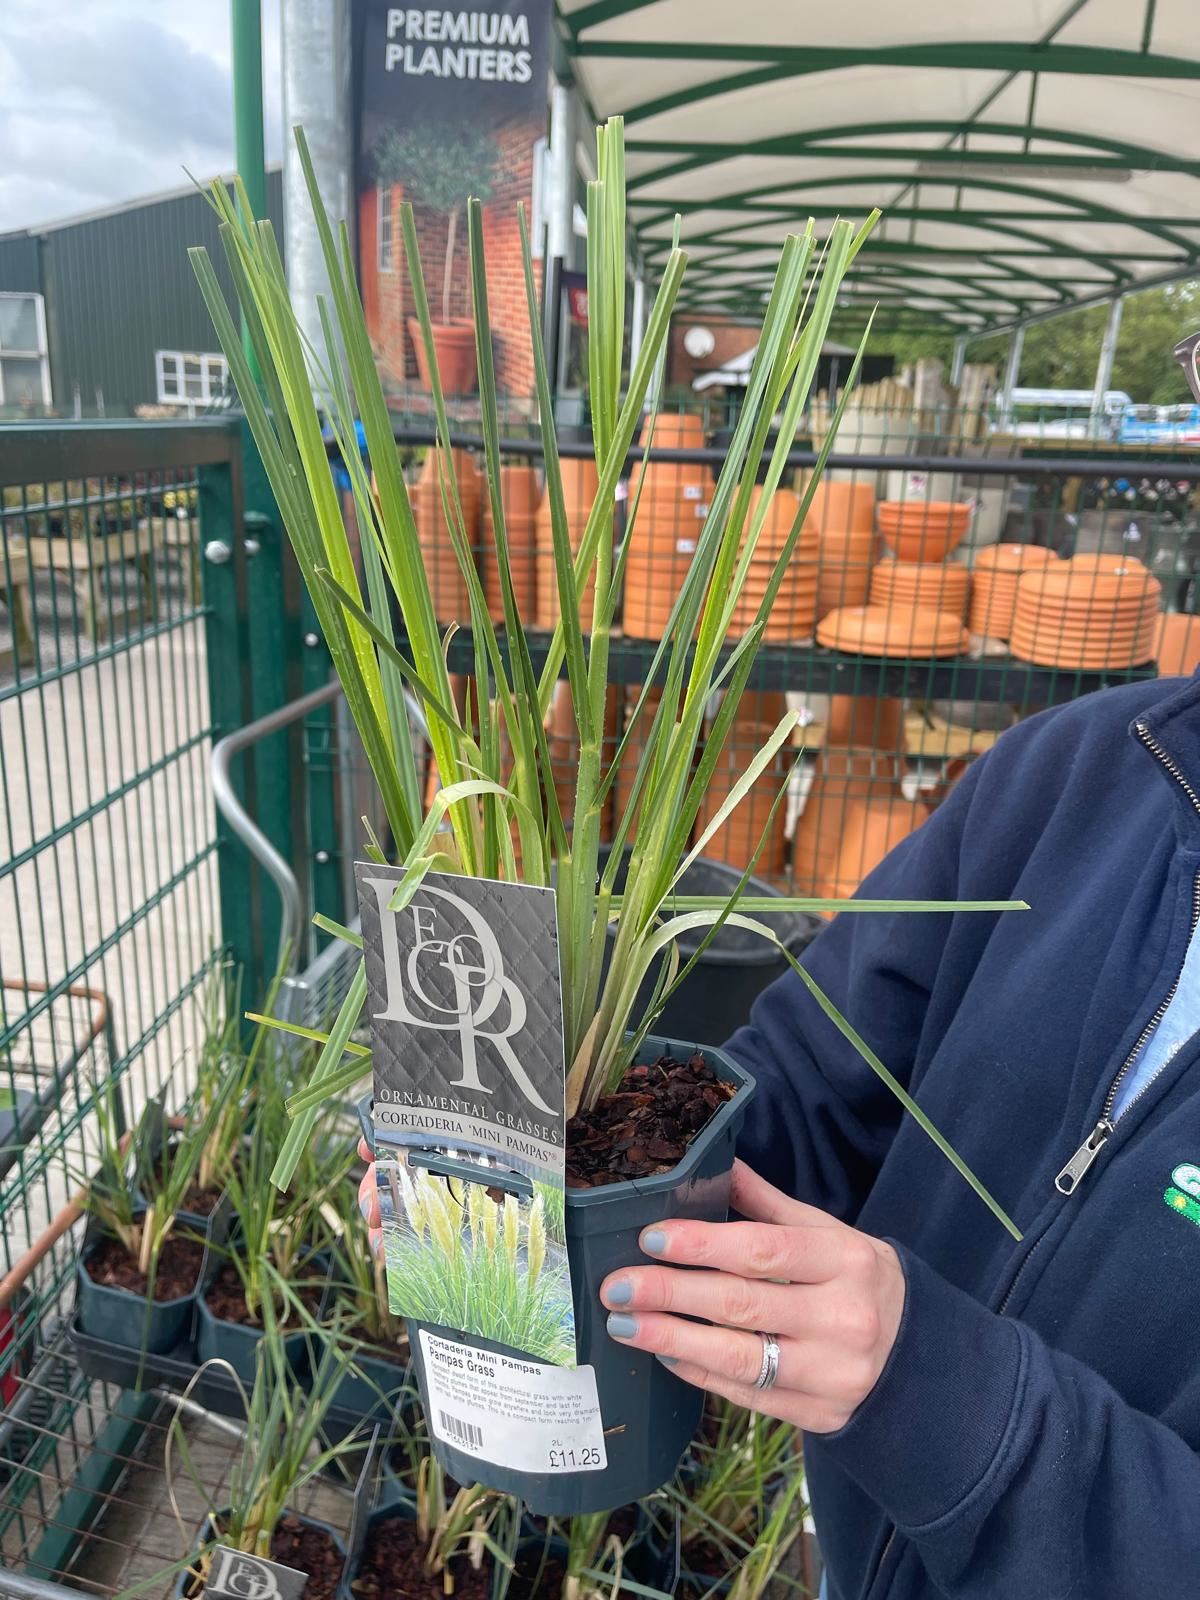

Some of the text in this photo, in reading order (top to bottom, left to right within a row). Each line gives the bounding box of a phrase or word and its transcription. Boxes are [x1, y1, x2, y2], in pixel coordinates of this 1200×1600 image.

[386, 8, 530, 46] PREMIUM
[385, 43, 532, 83] PLANTERS
[380, 1089, 558, 1144] ORNAMENTAL GRASSES
[381, 1111, 463, 1133] CORTADERIA
[427, 1335, 542, 1376] Cortaderia Mini Pampas
[429, 1346, 495, 1378] Pampas Grass
[533, 1393, 549, 1401] grass
[574, 1407, 599, 1415] dramatic
[549, 1447, 601, 1467] £11.25
